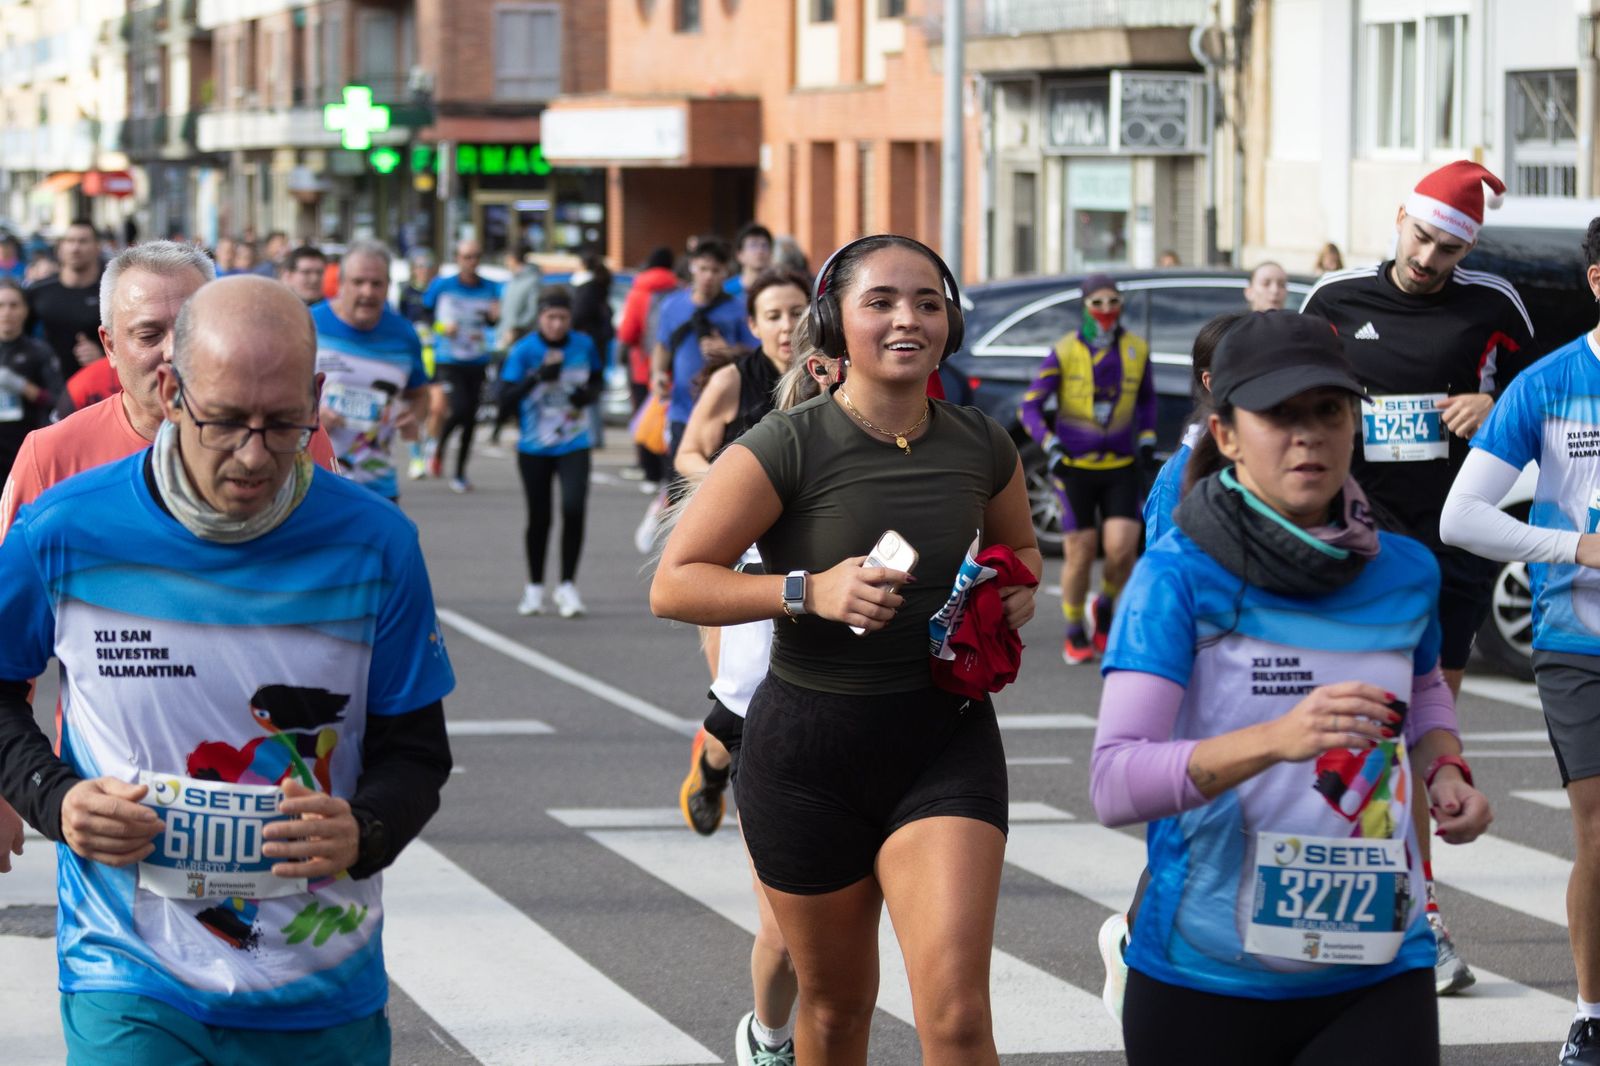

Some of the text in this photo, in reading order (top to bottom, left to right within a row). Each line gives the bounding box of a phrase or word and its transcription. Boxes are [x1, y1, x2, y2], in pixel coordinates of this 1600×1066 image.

[1374, 412, 1429, 441] 5254
[1567, 430, 1599, 440] XLI SAN
[1568, 440, 1600, 449] SILVEST
[94, 630, 151, 642] XLI SAN
[96, 647, 169, 660] SILVESTRE
[1252, 657, 1300, 667] XLI SAN
[98, 665, 196, 677] SALMANTINA
[1252, 671, 1313, 681] SILVESTRE
[164, 810, 263, 863] 6100
[1305, 845, 1396, 866] SETEL
[175, 861, 226, 873] ALBERTO
[1277, 869, 1378, 923] 3272
